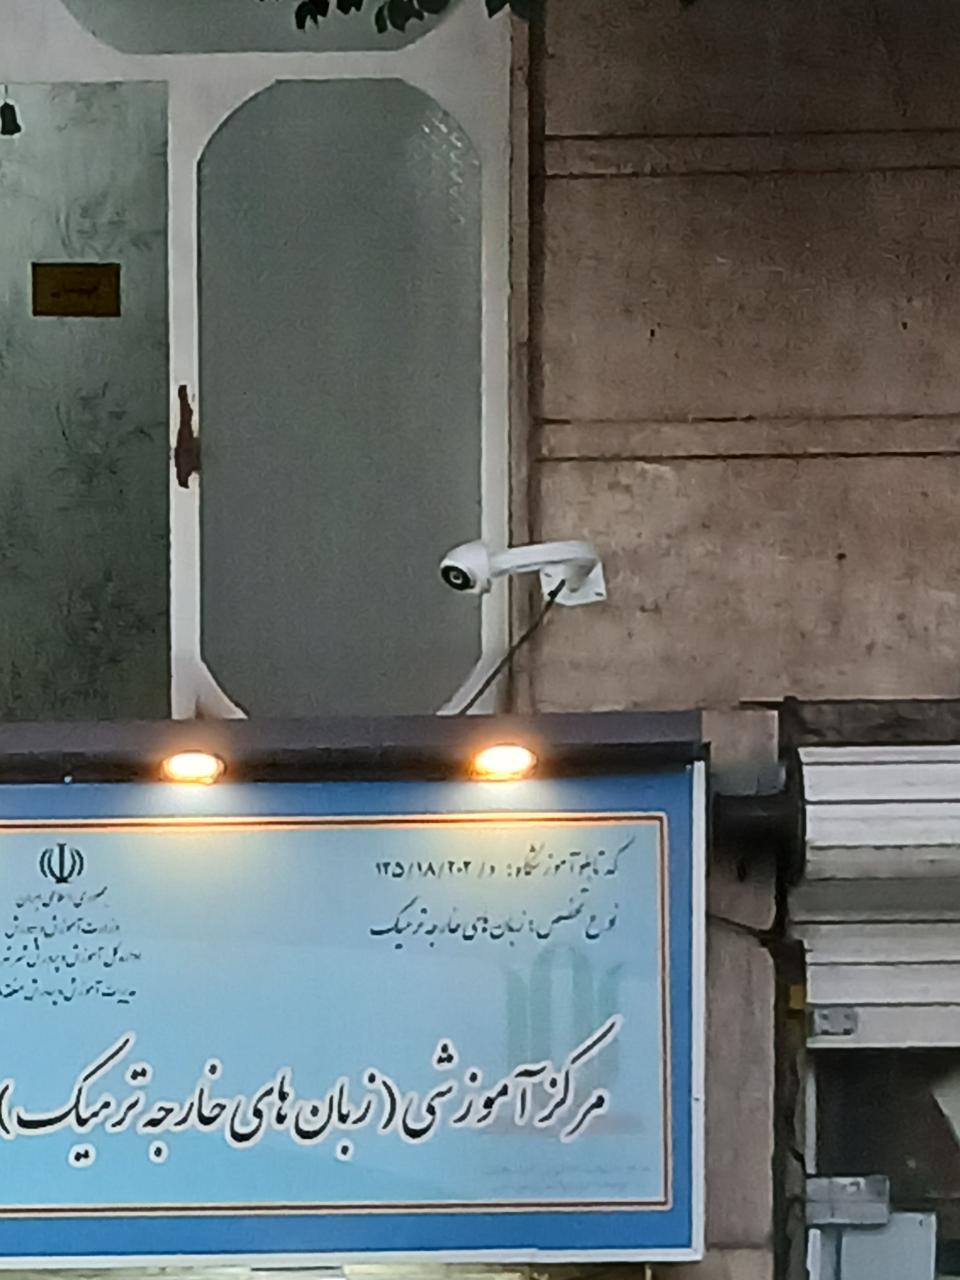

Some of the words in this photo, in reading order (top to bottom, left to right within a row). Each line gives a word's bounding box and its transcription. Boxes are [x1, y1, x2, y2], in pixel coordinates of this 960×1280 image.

[585, 902, 619, 939] نوع
[142, 1063, 228, 1157] خارجه
[229, 1074, 290, 1143] های
[402, 1042, 548, 1140] آموزشی
[538, 1020, 618, 1138] مرکز
